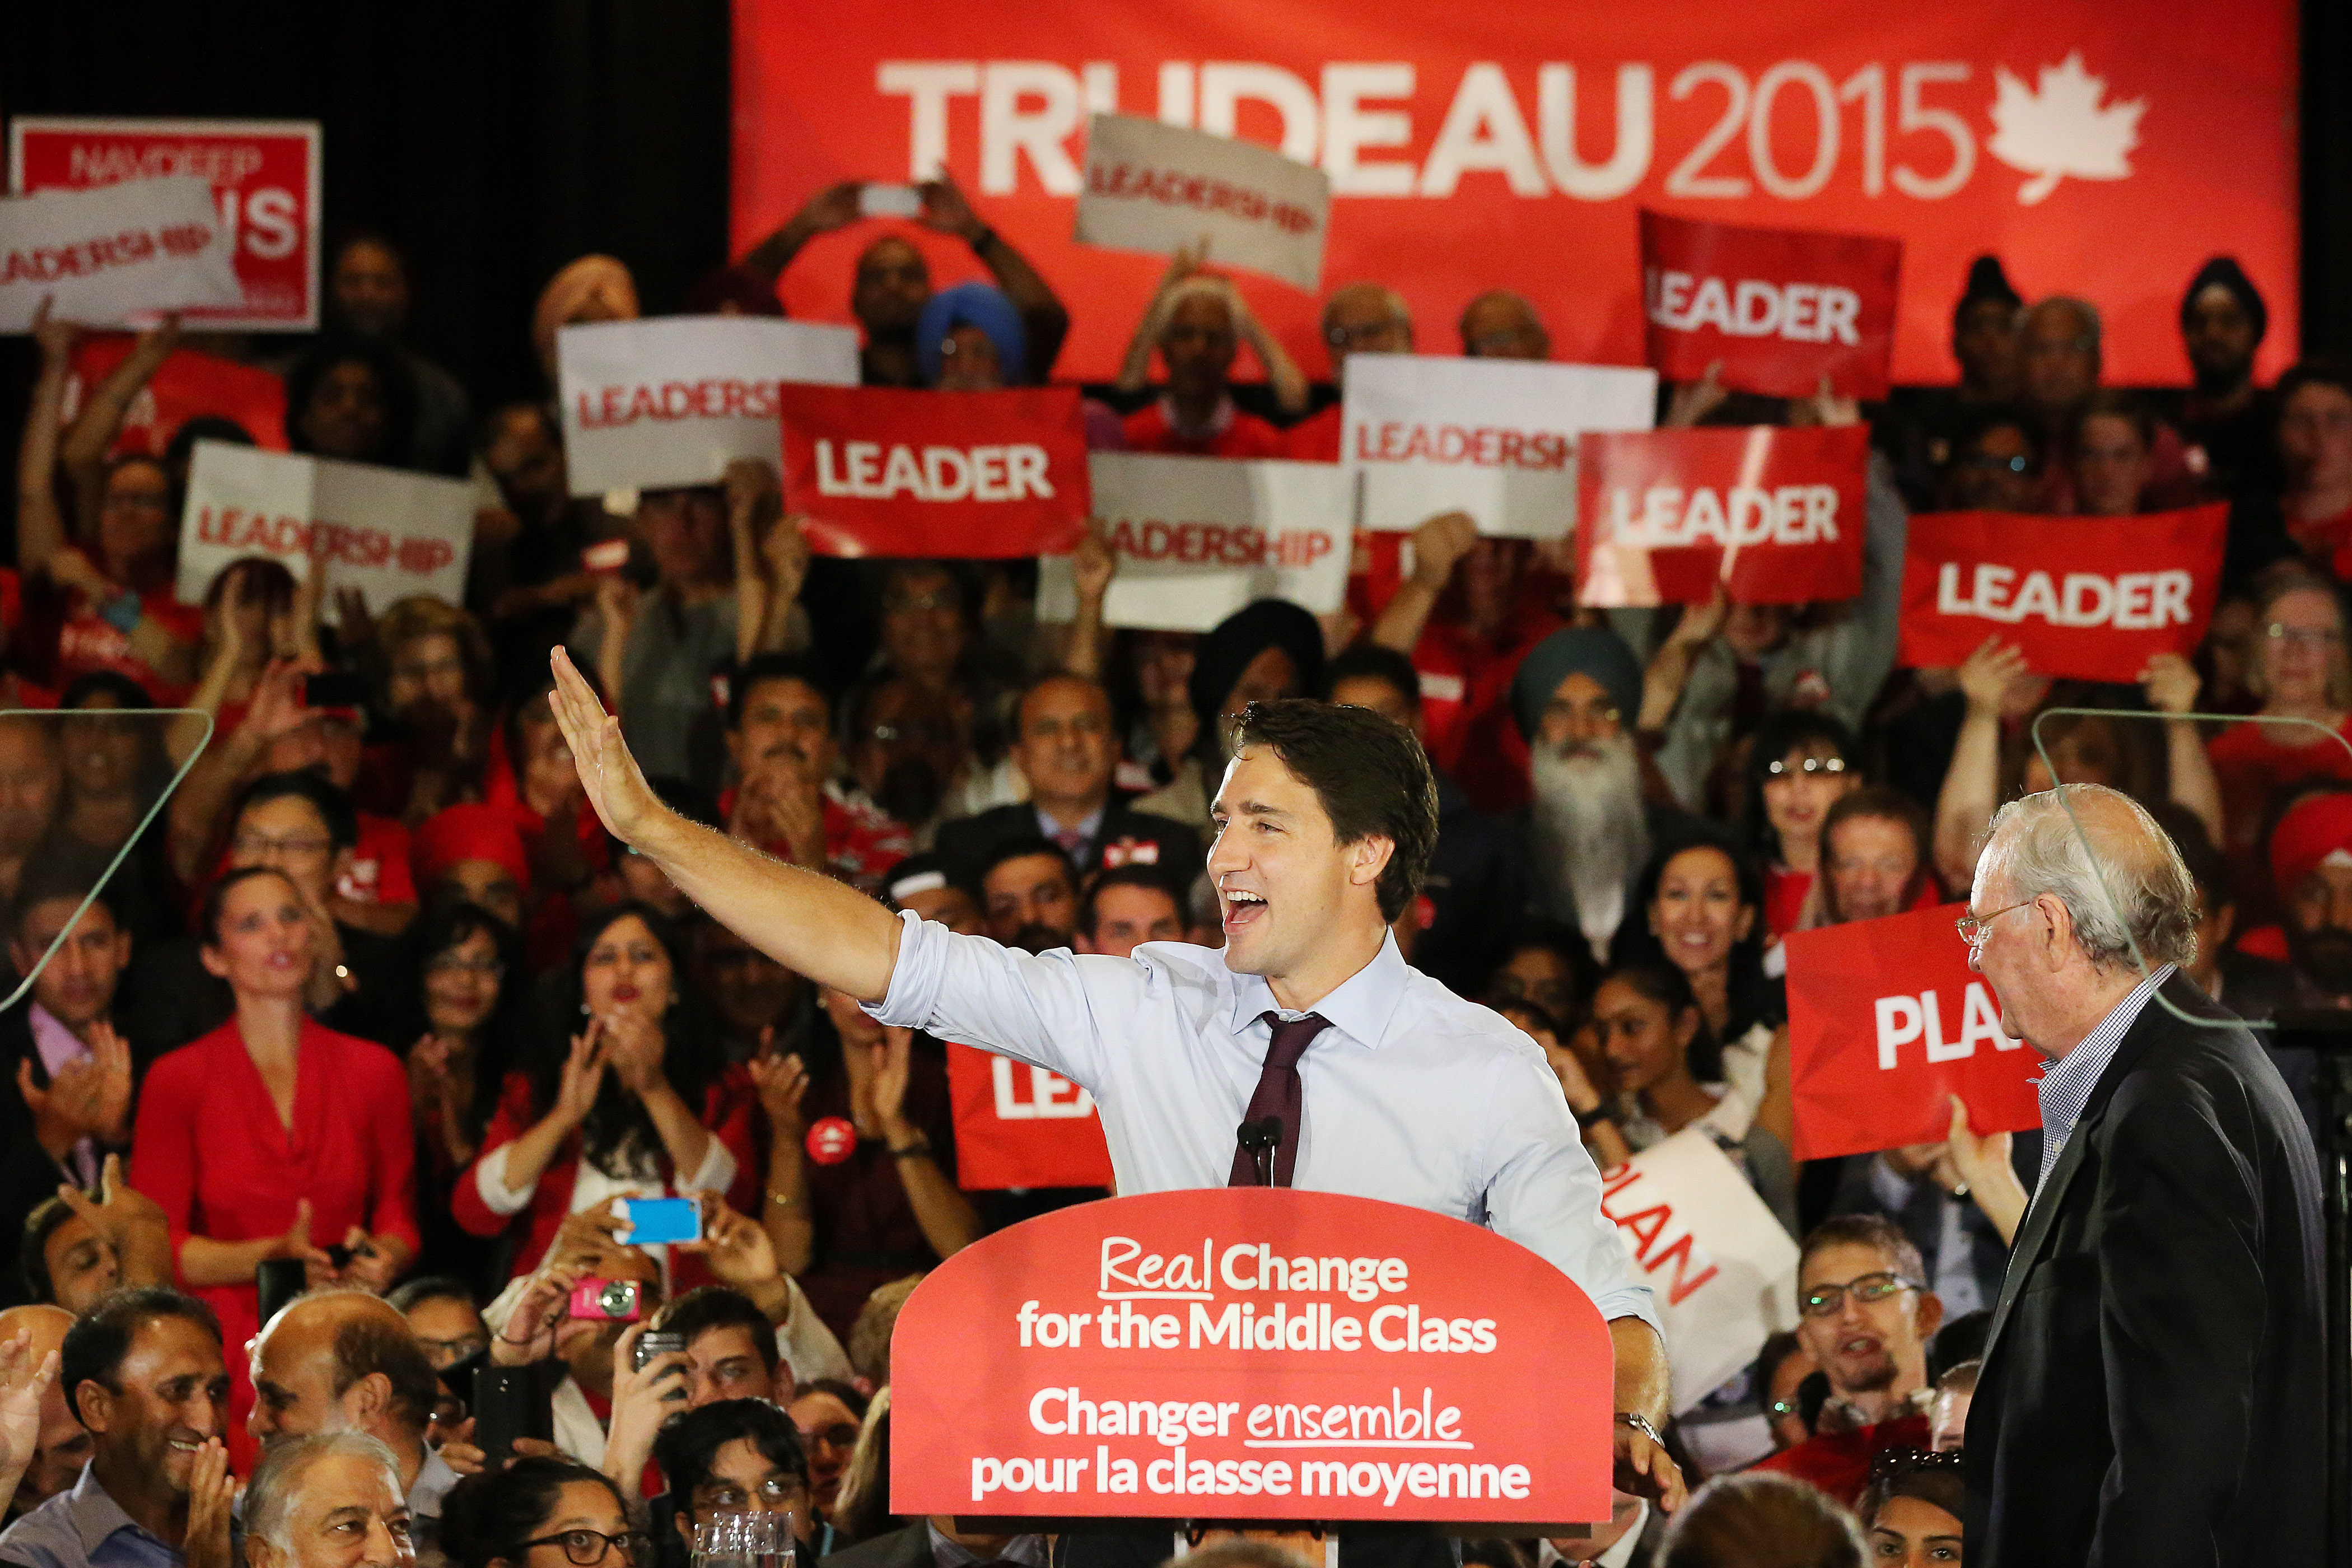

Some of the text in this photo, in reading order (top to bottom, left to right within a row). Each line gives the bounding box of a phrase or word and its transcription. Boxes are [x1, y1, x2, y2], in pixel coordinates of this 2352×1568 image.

[1646, 265, 1861, 346] LEADER
[816, 438, 1054, 501] LEADER
[1613, 484, 1840, 549] LEADER
[1938, 561, 2192, 631] LEADER
[991, 1055, 1095, 1119] LE
[1099, 1235, 1408, 1303] Real Change
[1015, 1300, 1498, 1354] for the Middle Class
[1028, 1386, 1463, 1446] Changer ensemble
[971, 1445, 1532, 1508] pour la classe moyenne
